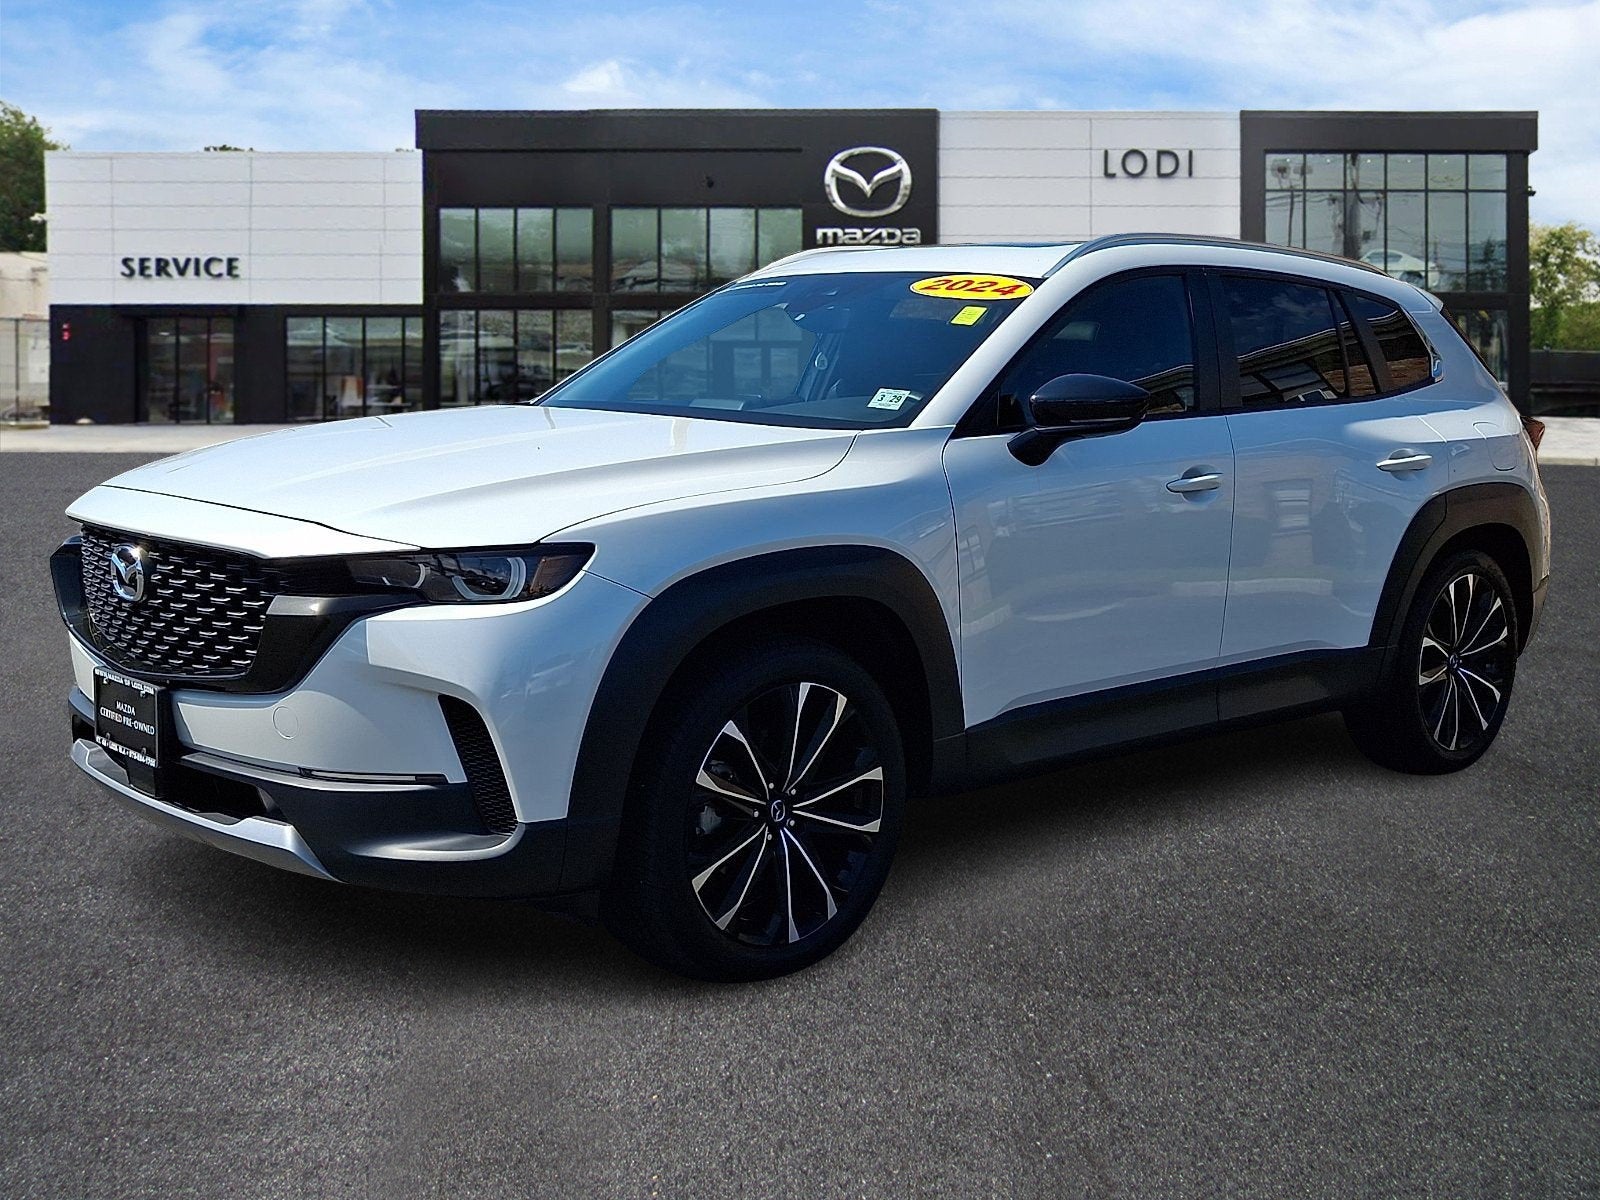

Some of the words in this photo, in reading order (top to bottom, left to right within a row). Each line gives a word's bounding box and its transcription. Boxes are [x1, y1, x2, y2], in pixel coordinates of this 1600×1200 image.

[1103, 149, 1193, 178] LODI
[816, 228, 921, 244] mazda
[120, 257, 240, 278] SERVICE
[919, 279, 1022, 295] 2024
[877, 394, 886, 402] 3
[888, 395, 903, 404] 29
[116, 700, 136, 717] MAZDA
[100, 706, 122, 723] CERTIFIED
[122, 715, 155, 735] PRE-OWNED
